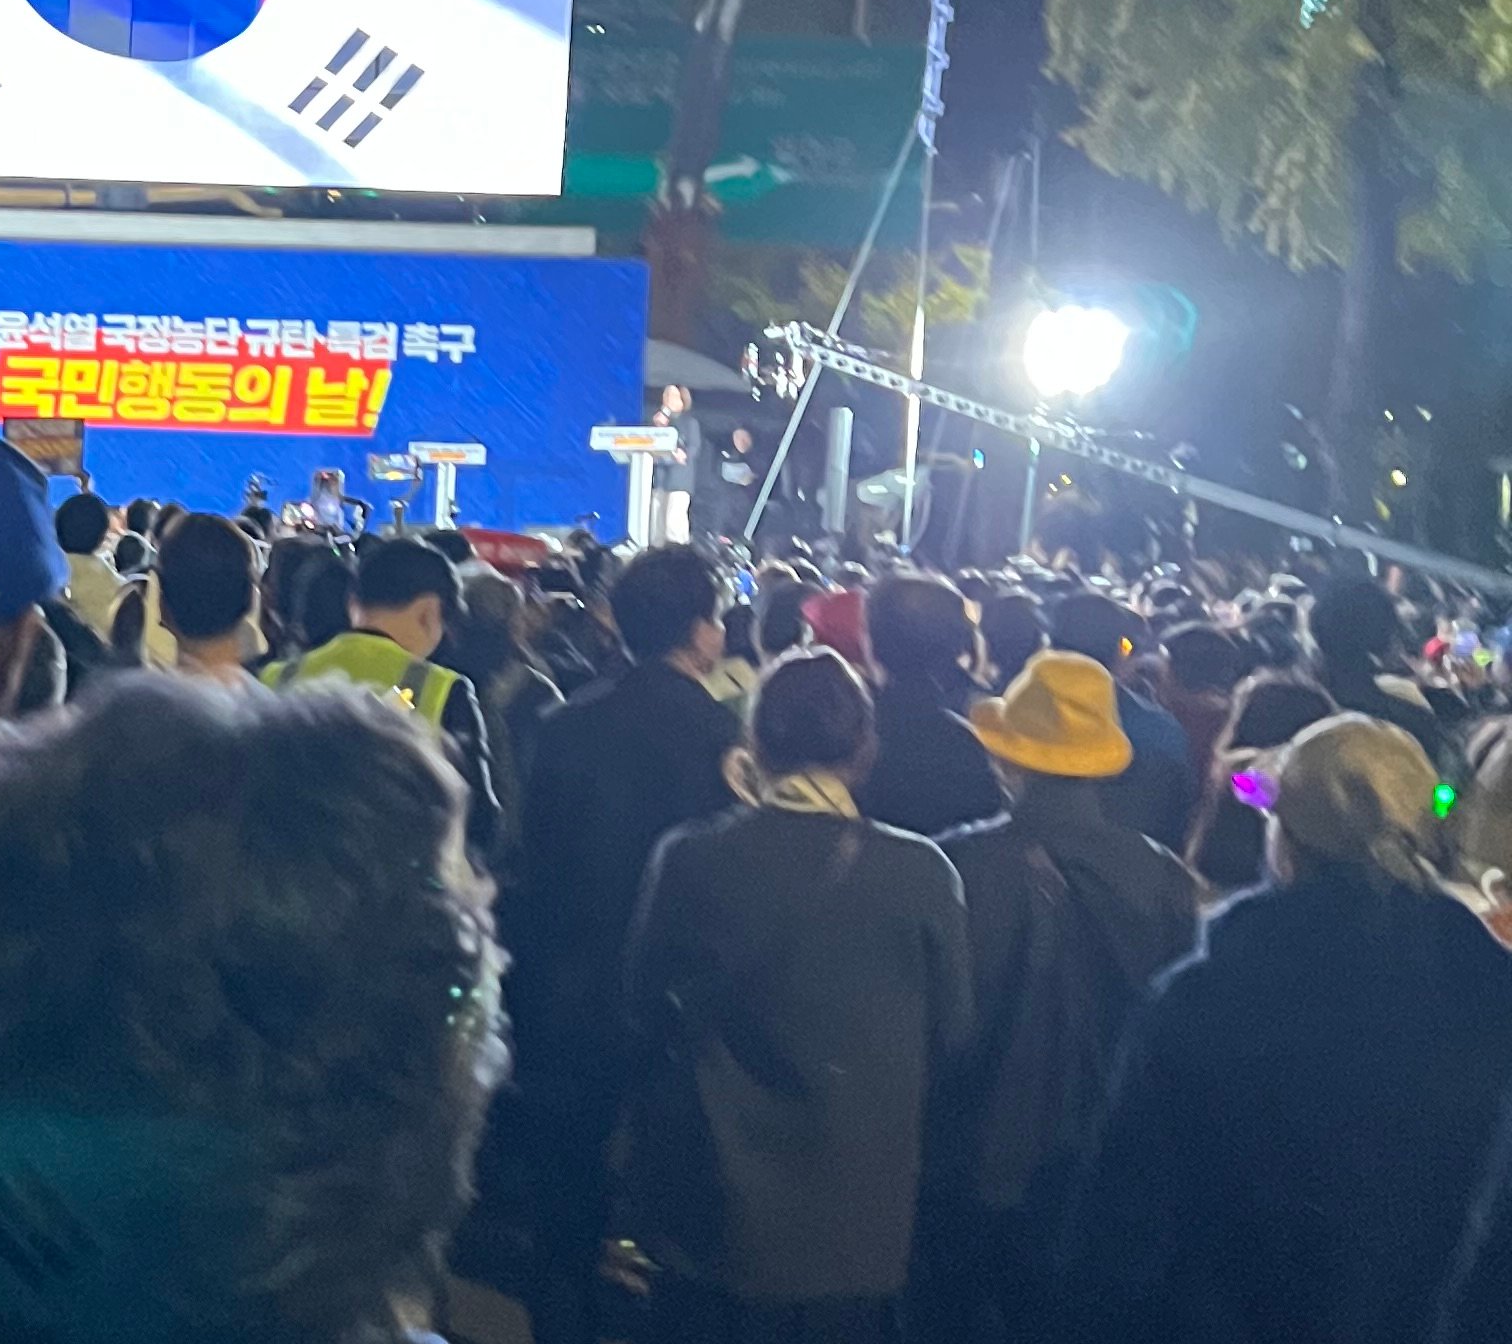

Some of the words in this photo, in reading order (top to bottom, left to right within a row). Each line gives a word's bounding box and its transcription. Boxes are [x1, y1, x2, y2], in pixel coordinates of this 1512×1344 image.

[101, 314, 244, 356] 국정농단
[402, 321, 477, 363] 촉구
[1, 356, 292, 424] 국민행동의
[304, 366, 392, 429] 날!
